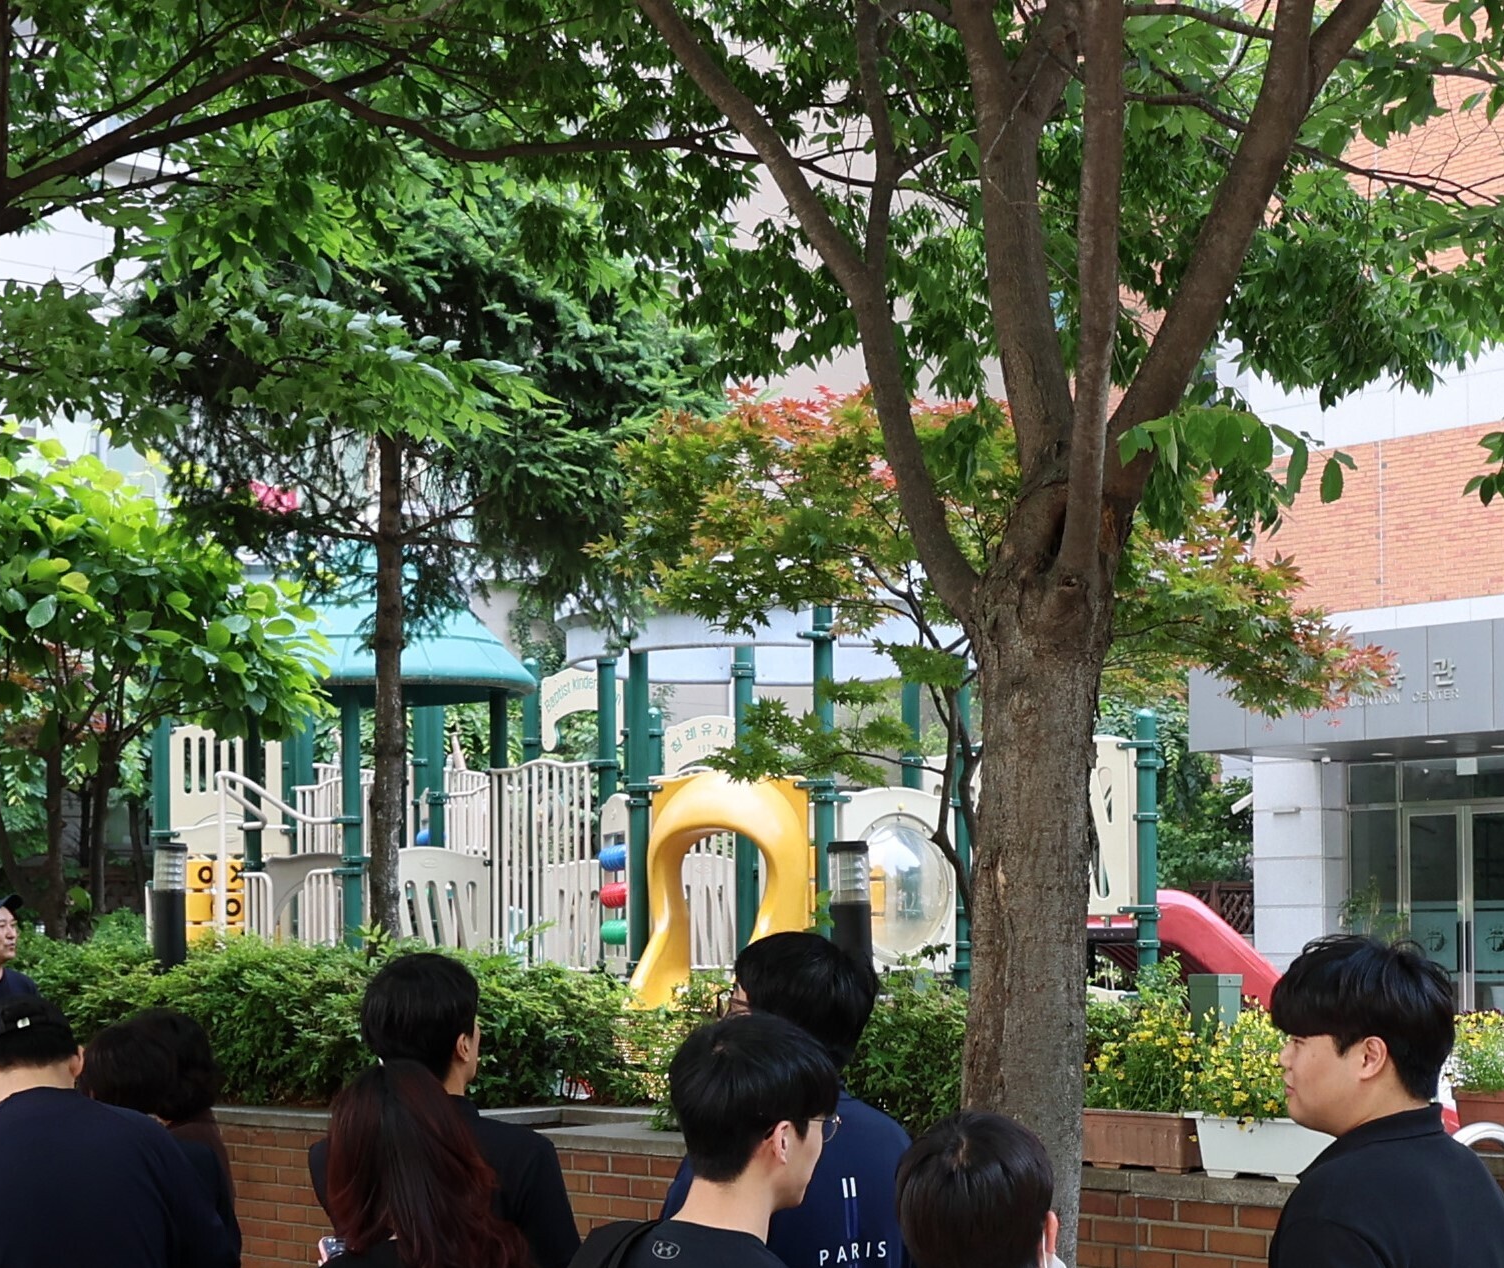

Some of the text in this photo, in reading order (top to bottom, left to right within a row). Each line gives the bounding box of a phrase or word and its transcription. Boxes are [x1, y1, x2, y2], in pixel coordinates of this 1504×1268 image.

[1347, 687, 1460, 708] UCATION CENTER
[670, 722, 729, 753] 침례유치
[819, 1241, 887, 1267] PARIS
